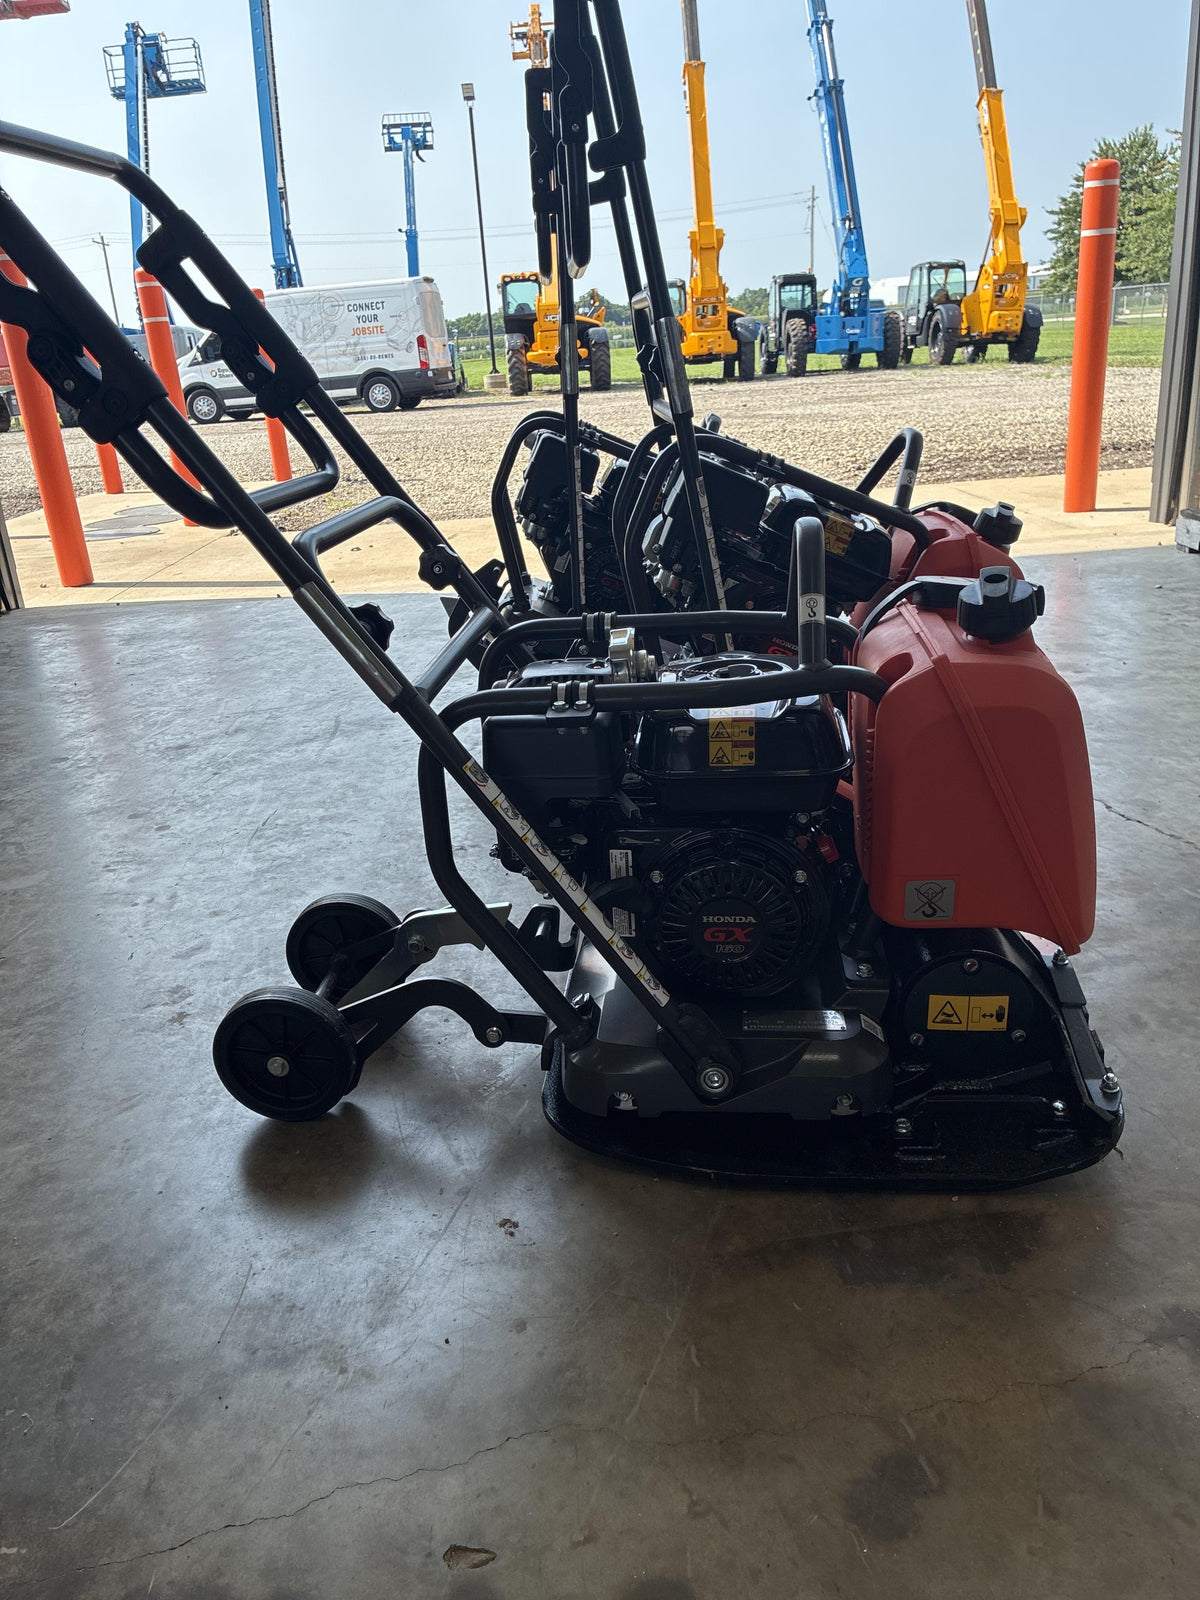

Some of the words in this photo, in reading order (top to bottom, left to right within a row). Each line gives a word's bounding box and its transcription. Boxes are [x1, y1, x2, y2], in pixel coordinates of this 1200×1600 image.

[347, 301, 386, 313] CONNECT
[356, 313, 379, 324] YOUR
[351, 325, 388, 337] JOBSITE.
[771, 636, 799, 651] HOND
[702, 915, 757, 923] HONDA
[703, 927, 754, 942] GX
[715, 944, 745, 953] 160
